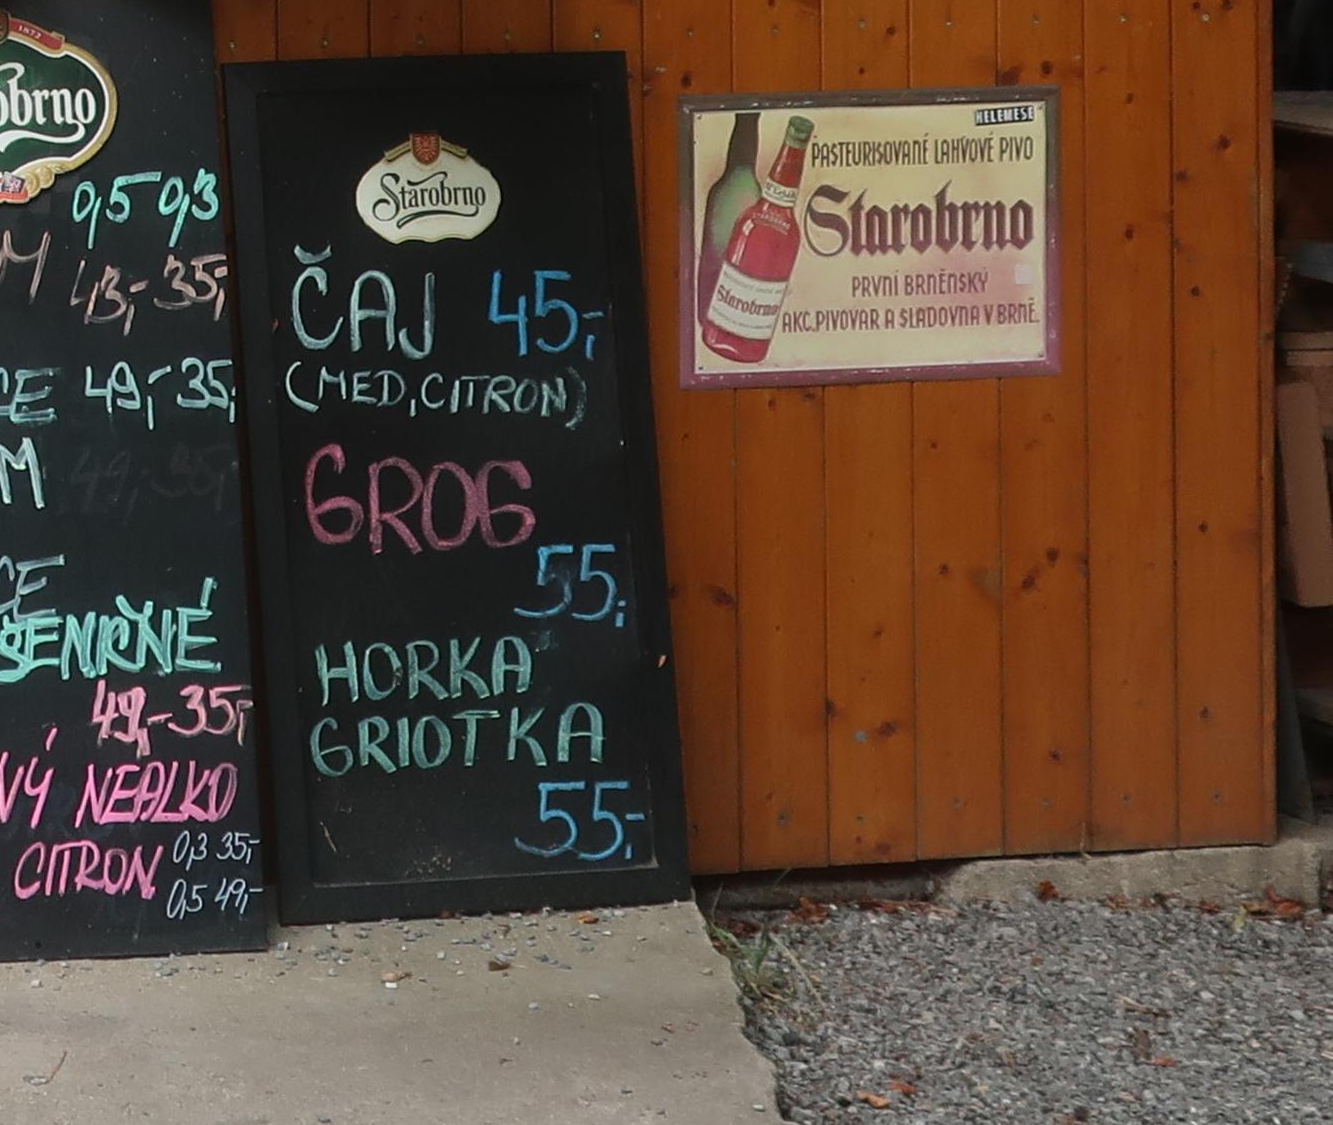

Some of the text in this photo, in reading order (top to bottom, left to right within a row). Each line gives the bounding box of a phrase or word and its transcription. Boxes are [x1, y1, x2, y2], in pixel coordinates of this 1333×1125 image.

[811, 133, 929, 168] PASTEURISOVANÉ
[999, 136, 1034, 162] PIVO
[71, 168, 221, 249] 0,5 0,3
[370, 170, 489, 228] Starobrno
[803, 180, 1034, 258] Starobrno
[290, 243, 605, 363] ČAJ 45,-
[851, 267, 988, 298] PRVNÍ BRNĚNSKÝ
[816, 307, 880, 332] PIVOVAR
[885, 308, 896, 328] A
[899, 303, 980, 329] SLADOVNA
[984, 303, 993, 325] V
[85, 361, 171, 430] 49,-
[422, 370, 587, 431] CITRON)
[303, 441, 537, 556] GROG
[309, 702, 605, 777] GRIOTKA
[75, 760, 238, 828] NEALKO
[513, 781, 645, 861] 55,-
[13, 843, 165, 903] CITRON
[170, 831, 208, 870] 0,3
[166, 875, 206, 922] 0,5
